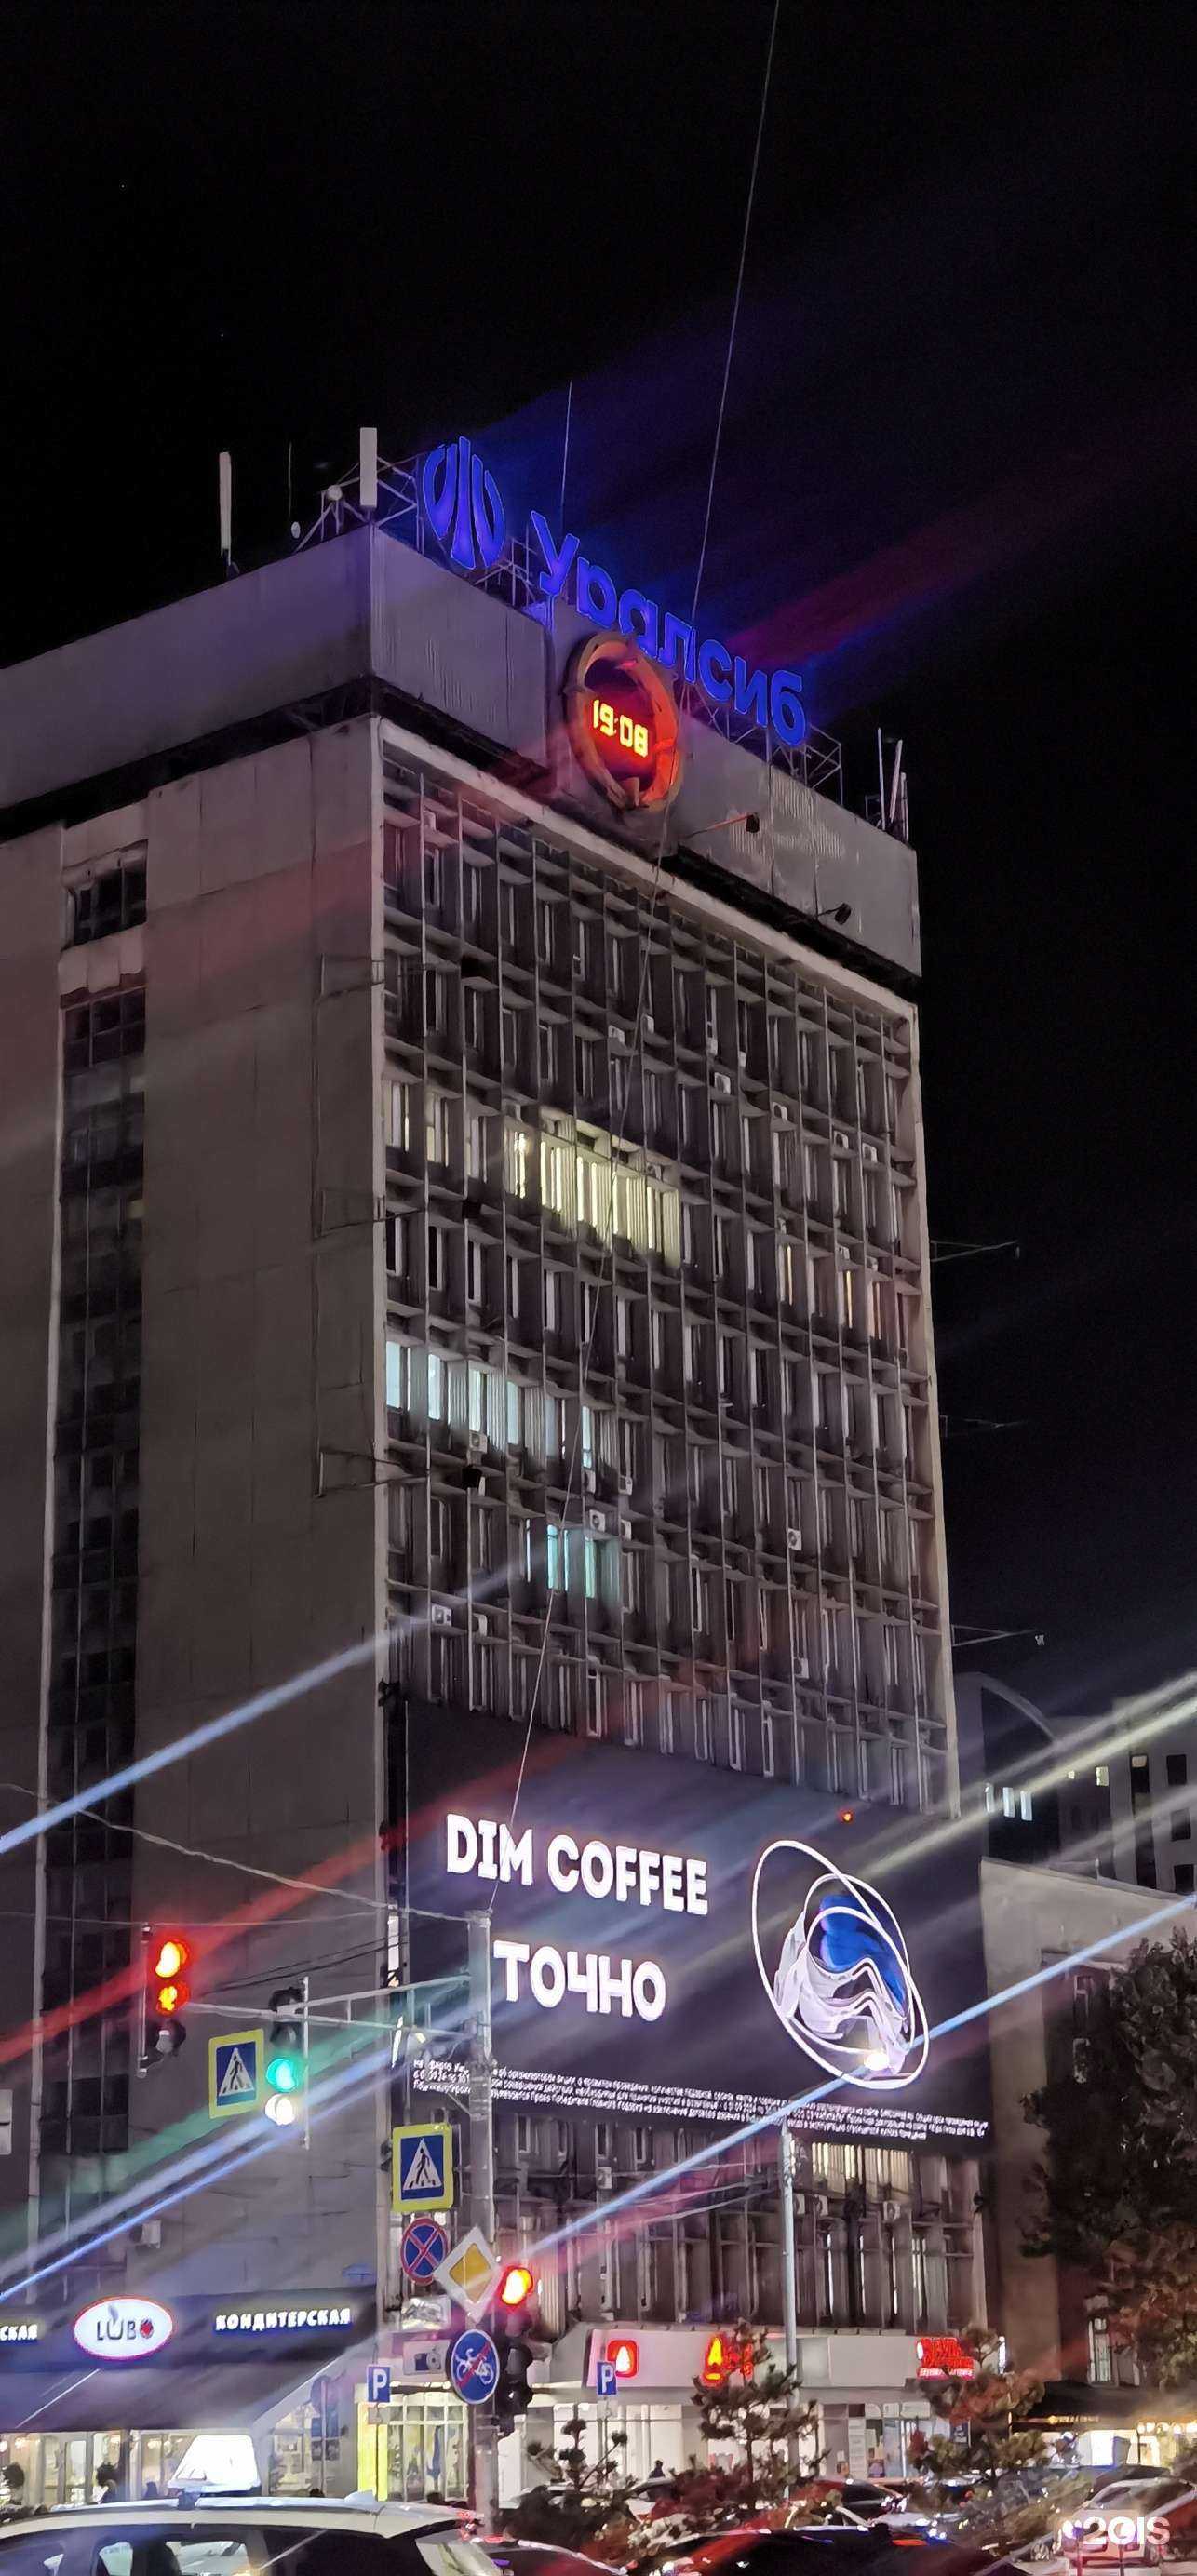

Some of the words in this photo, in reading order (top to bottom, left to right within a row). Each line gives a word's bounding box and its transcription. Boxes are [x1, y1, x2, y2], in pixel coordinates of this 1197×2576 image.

[531, 510, 806, 747] Уралсиб
[593, 699, 649, 758] 19:08
[447, 1814, 533, 1885] DIM
[547, 1834, 708, 1915] COFFEE
[493, 1940, 666, 2021] ТОЧНО
[215, 2308, 351, 2331] КОНДИТЕРСКАЯ
